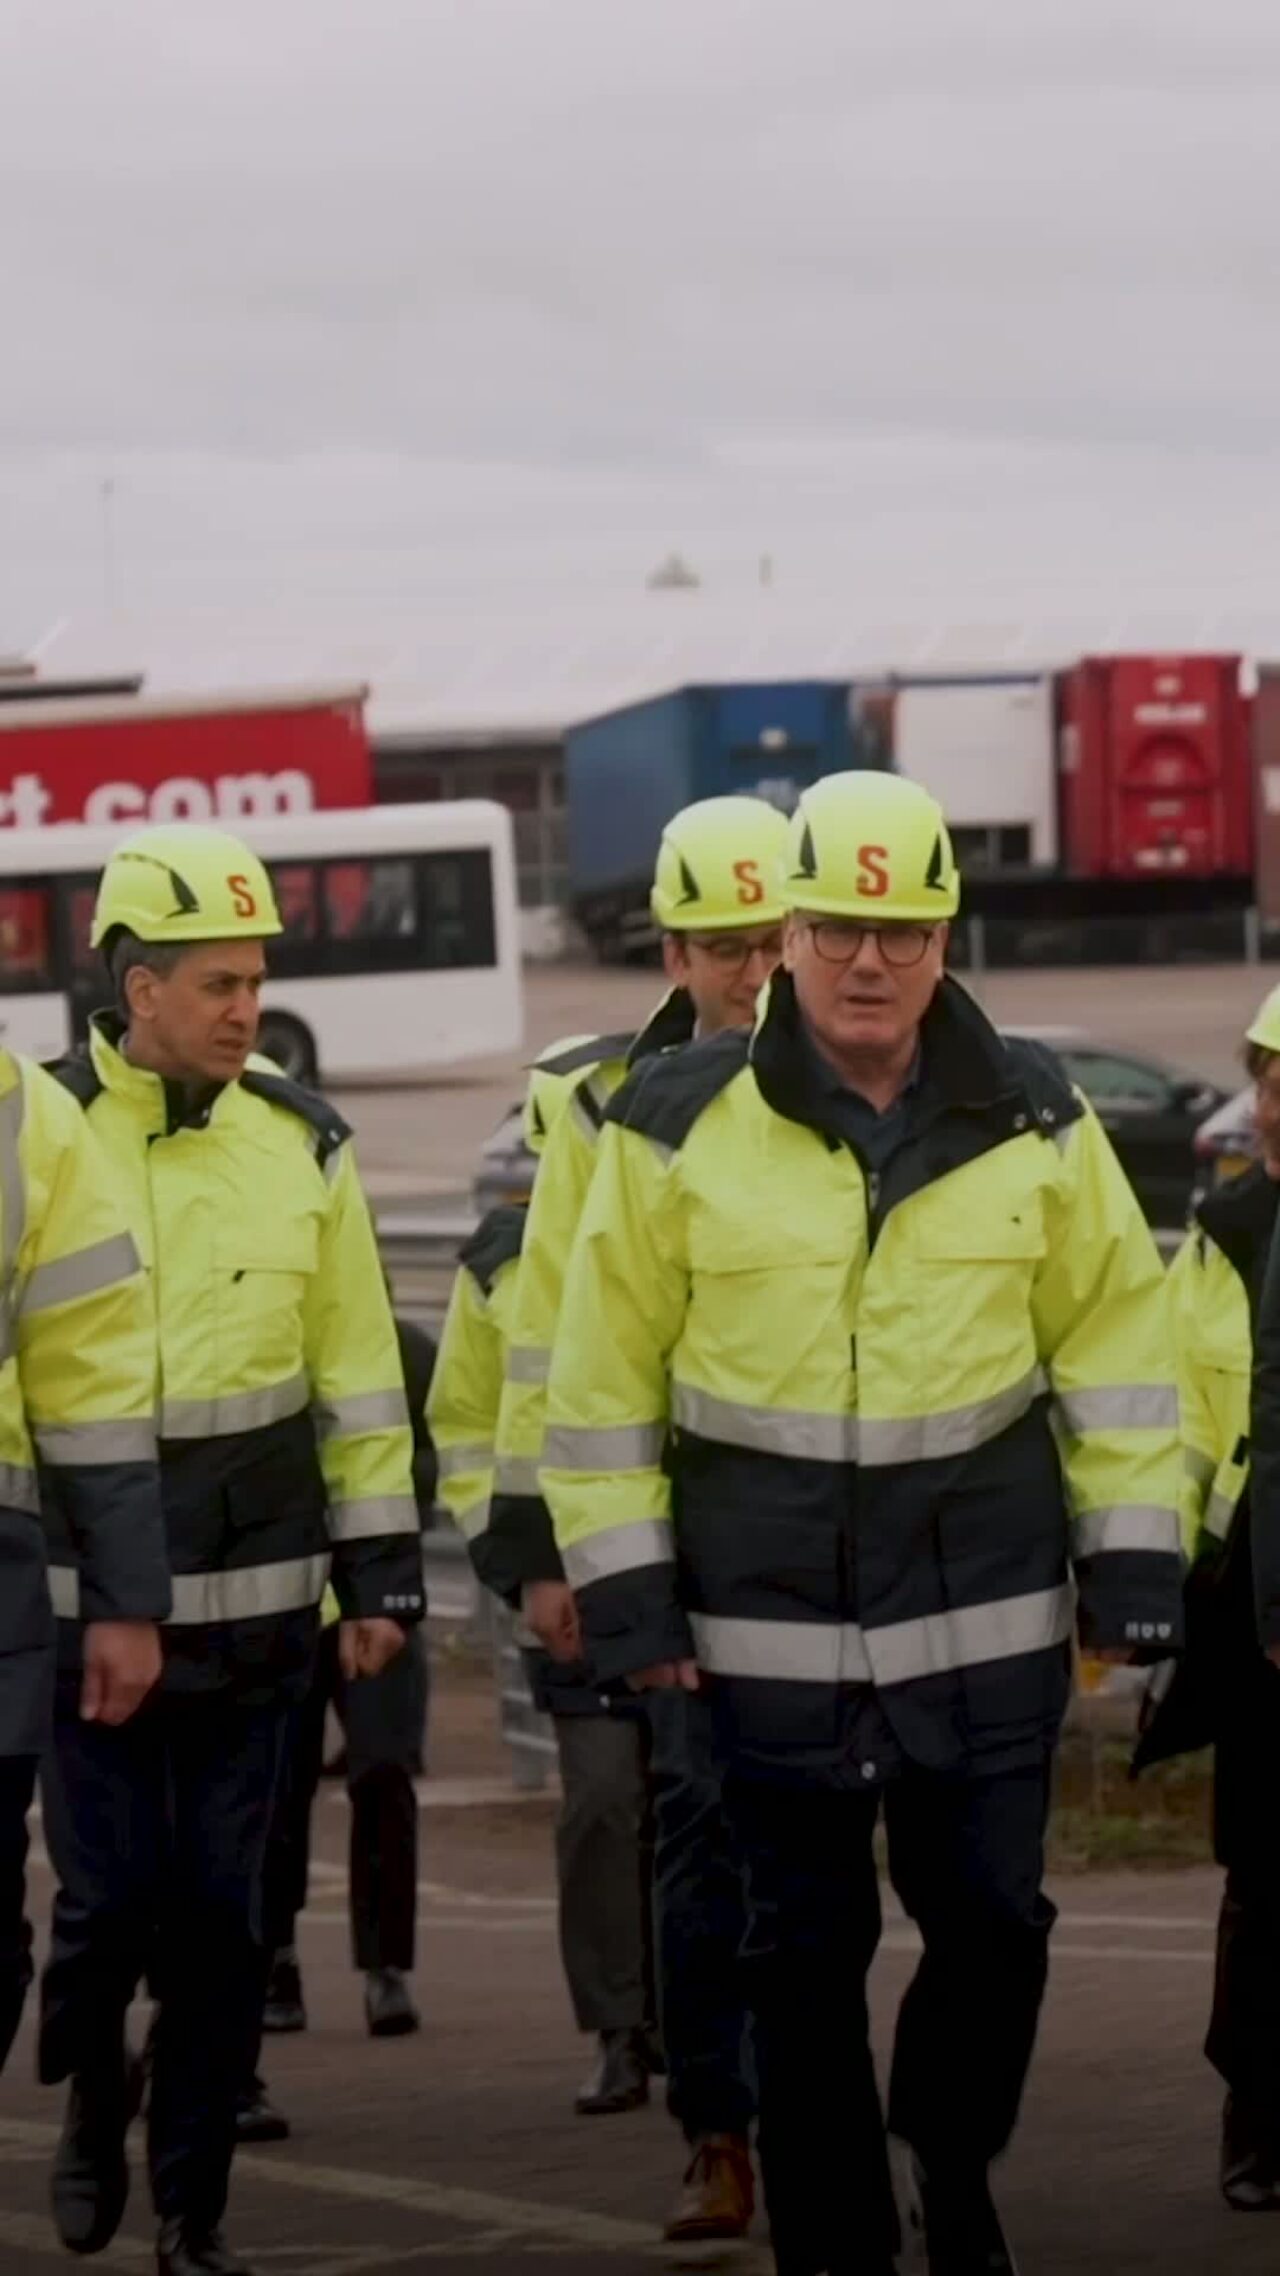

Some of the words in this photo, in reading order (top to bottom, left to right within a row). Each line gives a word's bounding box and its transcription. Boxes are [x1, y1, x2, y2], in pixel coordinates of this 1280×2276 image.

[734, 860, 764, 905] S
[856, 845, 889, 898] S
[226, 874, 256, 918] S
